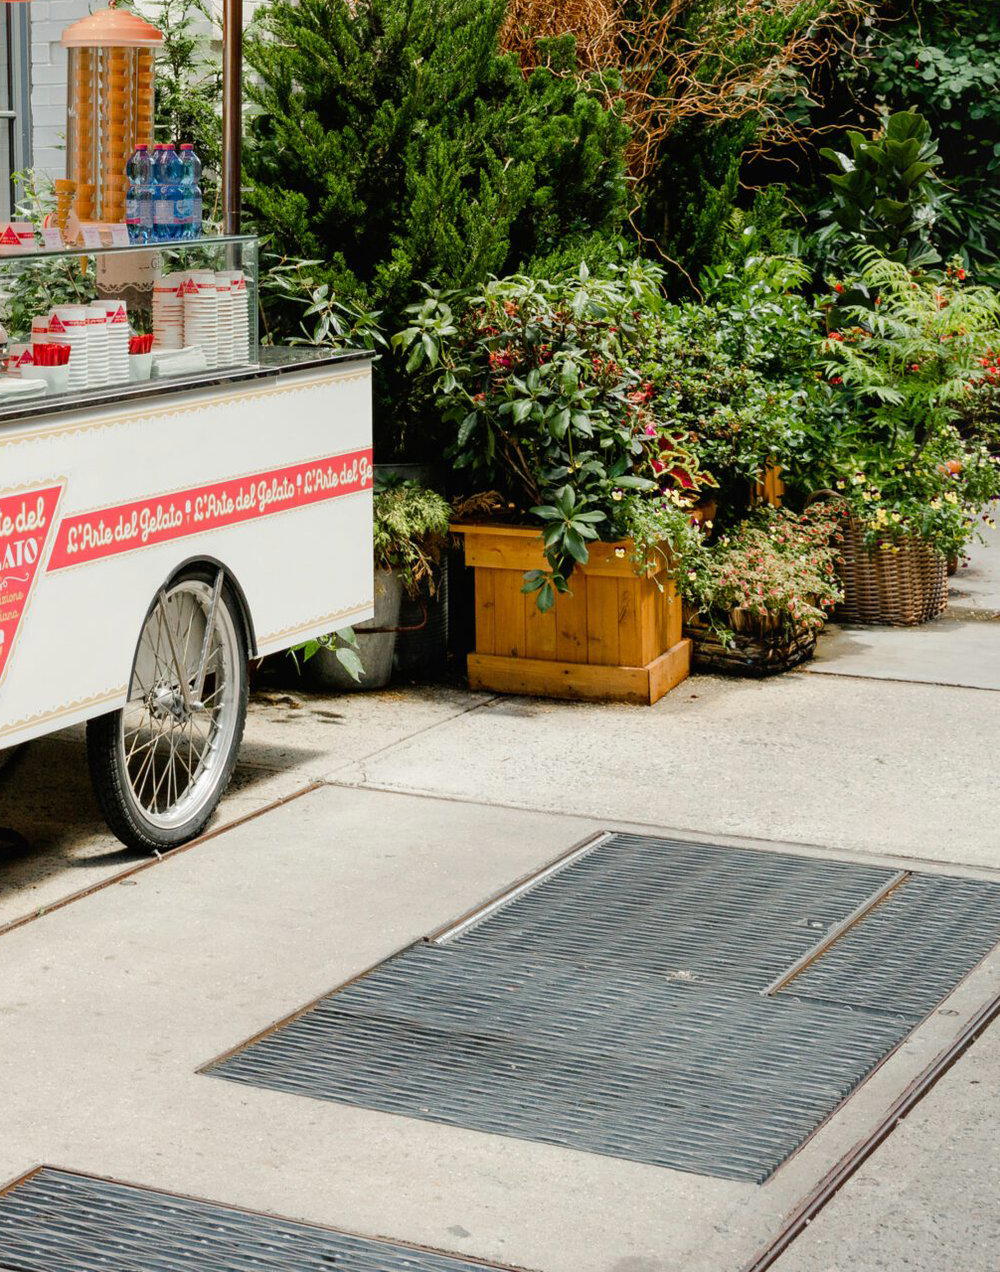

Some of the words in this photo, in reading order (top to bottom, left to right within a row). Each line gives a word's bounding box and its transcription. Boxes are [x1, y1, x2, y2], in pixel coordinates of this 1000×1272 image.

[304, 466, 339, 493] L'Arte
[340, 462, 359, 489] del
[15, 496, 46, 533] del
[194, 493, 235, 523] L'Arte
[236, 488, 257, 515] del
[257, 478, 295, 512] Gelato
[66, 521, 113, 554] L'Arte
[114, 518, 139, 546] del
[140, 508, 182, 542] Gelato
